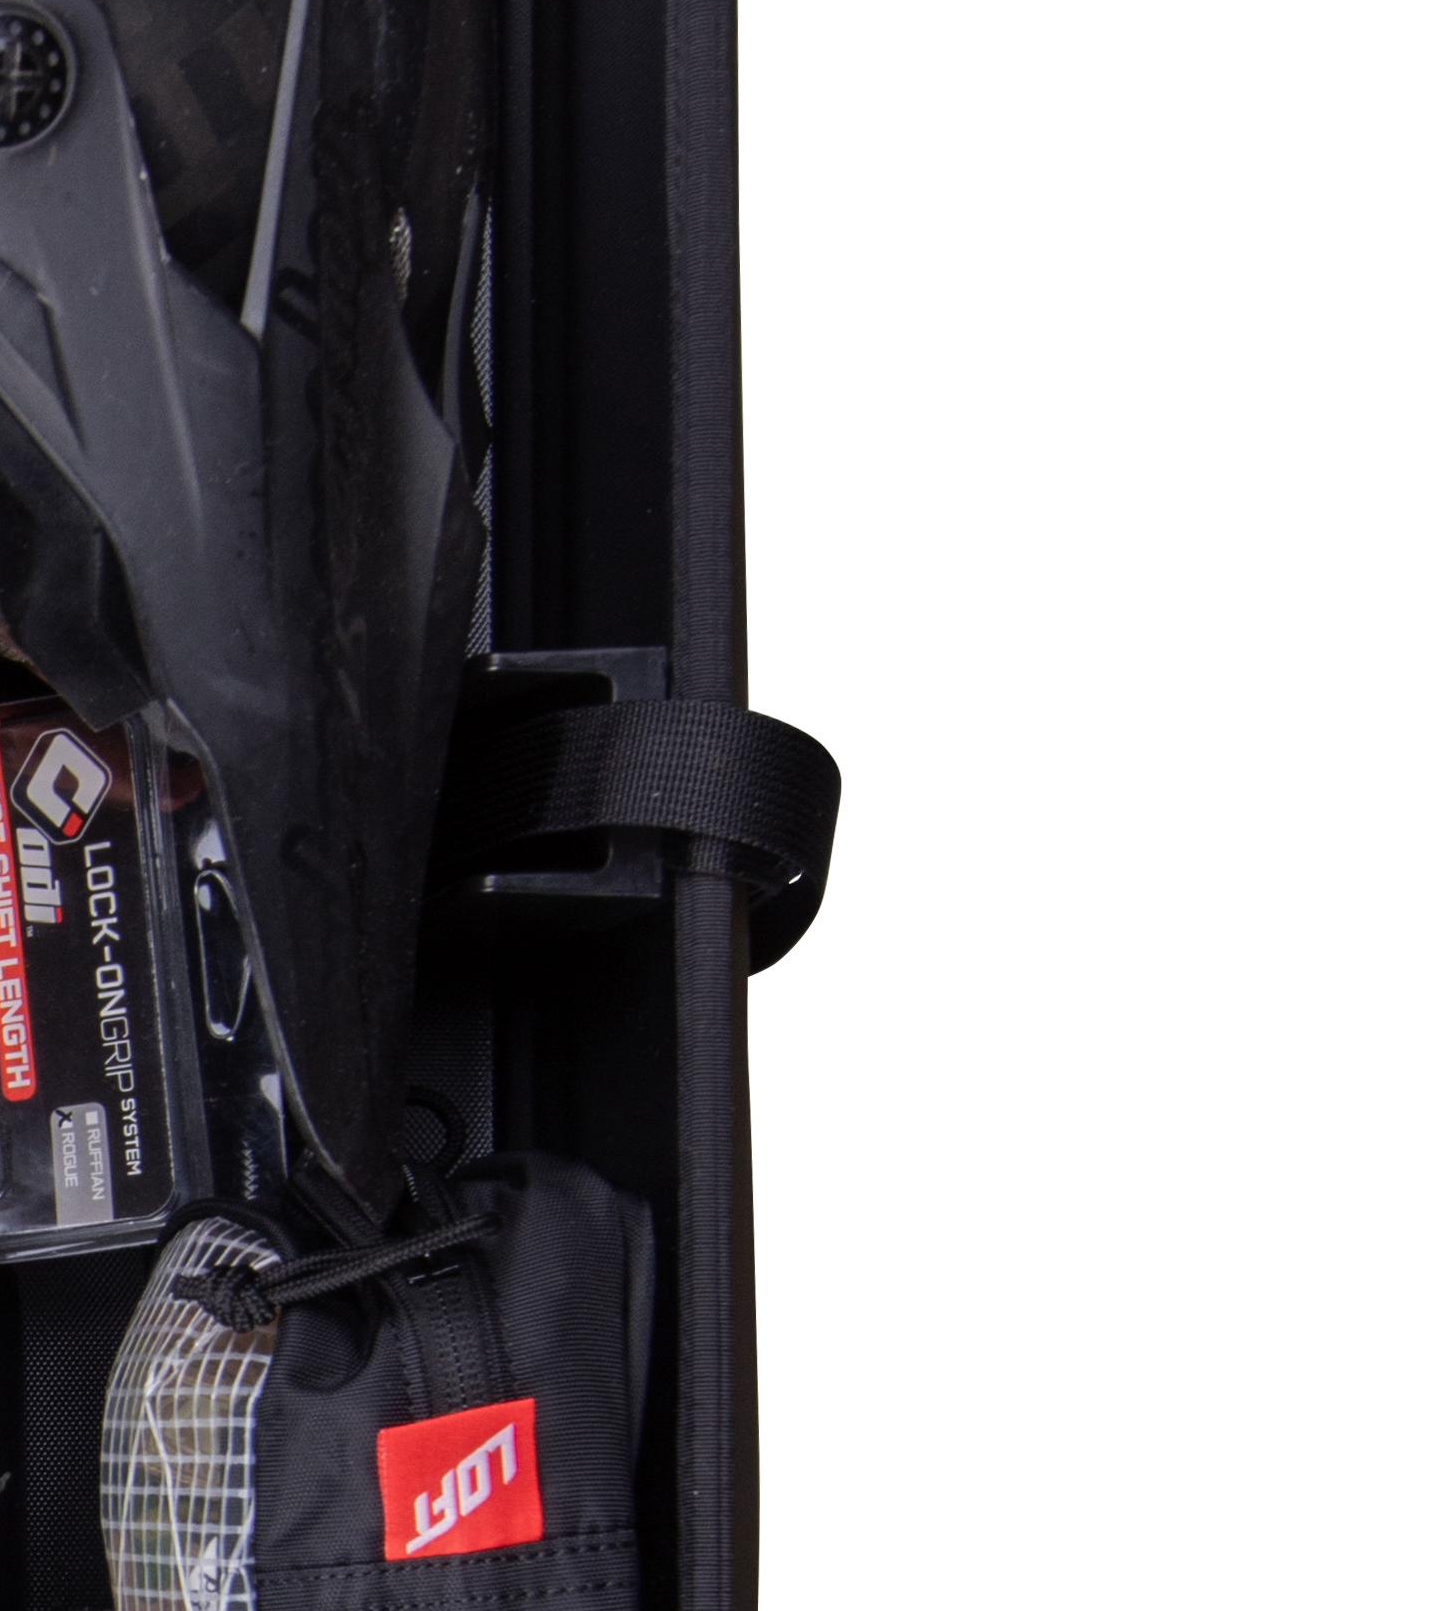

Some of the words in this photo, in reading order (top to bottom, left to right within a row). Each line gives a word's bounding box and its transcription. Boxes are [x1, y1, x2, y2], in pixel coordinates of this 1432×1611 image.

[60, 1131, 81, 1188] ROGUE
[85, 1127, 109, 1201] RUFFIAN
[120, 1097, 144, 1176] SYSTEM
[405, 1422, 518, 1556] LOFT
